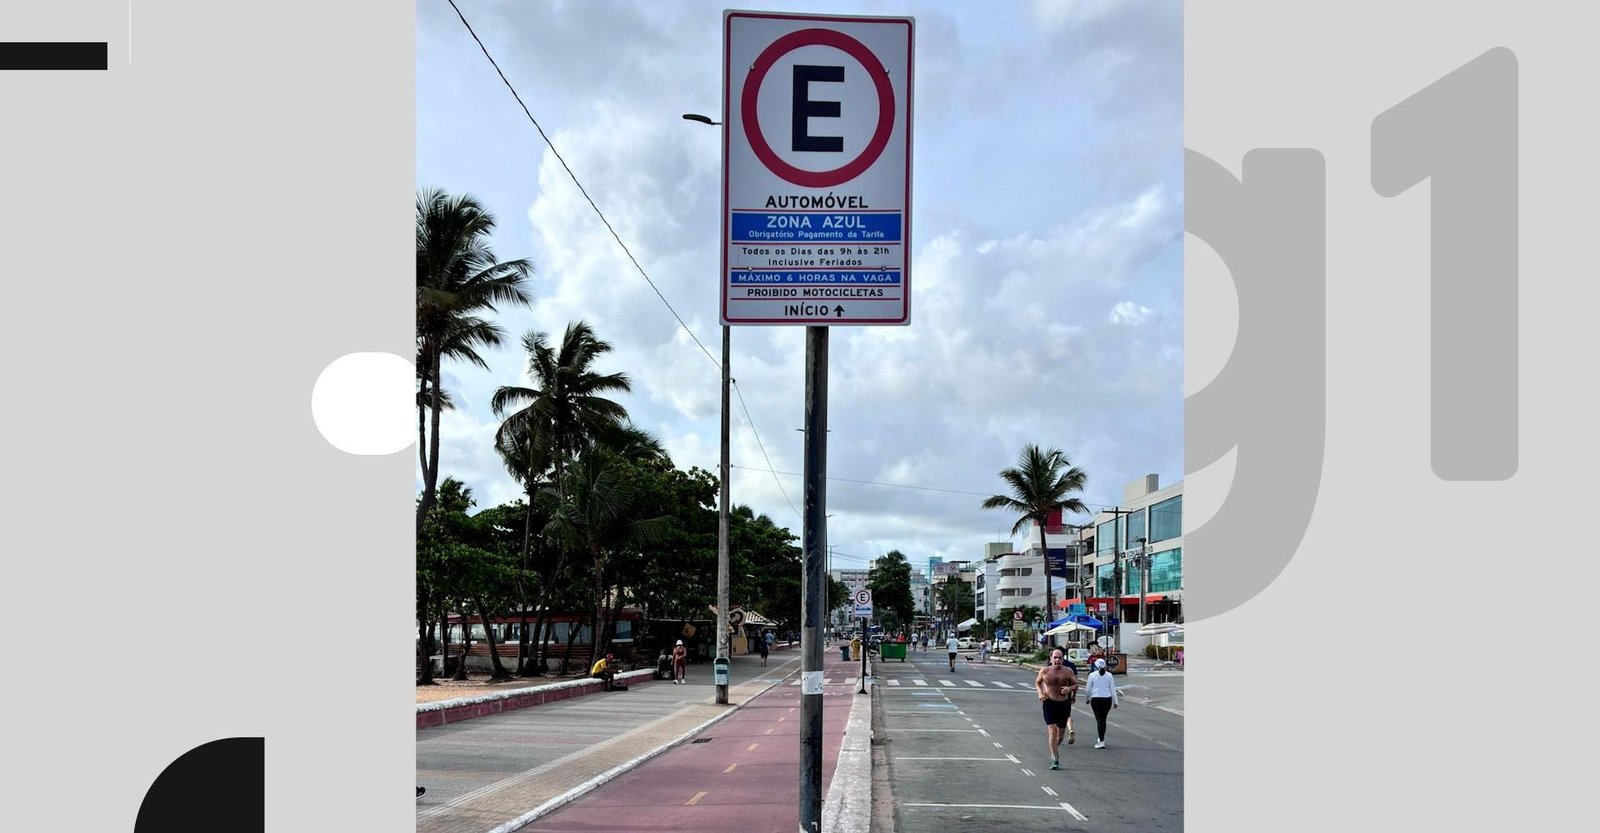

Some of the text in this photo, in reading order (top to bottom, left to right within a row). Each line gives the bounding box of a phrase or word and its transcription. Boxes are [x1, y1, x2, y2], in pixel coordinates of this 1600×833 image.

[792, 64, 845, 153] E
[765, 192, 868, 209] AUTOMÓVEL
[767, 216, 866, 228] ZONA AZUL
[748, 230, 884, 239] Obrigatório Pagamento da Tarifa
[742, 247, 770, 255] Todos
[857, 247, 868, 255] às
[873, 247, 890, 255] 21h
[787, 274, 793, 282] 6
[799, 274, 836, 282] HORAS
[842, 274, 856, 282] NA
[863, 274, 892, 282] VAGA
[748, 289, 883, 297] PROIBIDO MOTOCICLETAS
[785, 302, 828, 316] INÍCIO
[860, 593, 866, 602] E
